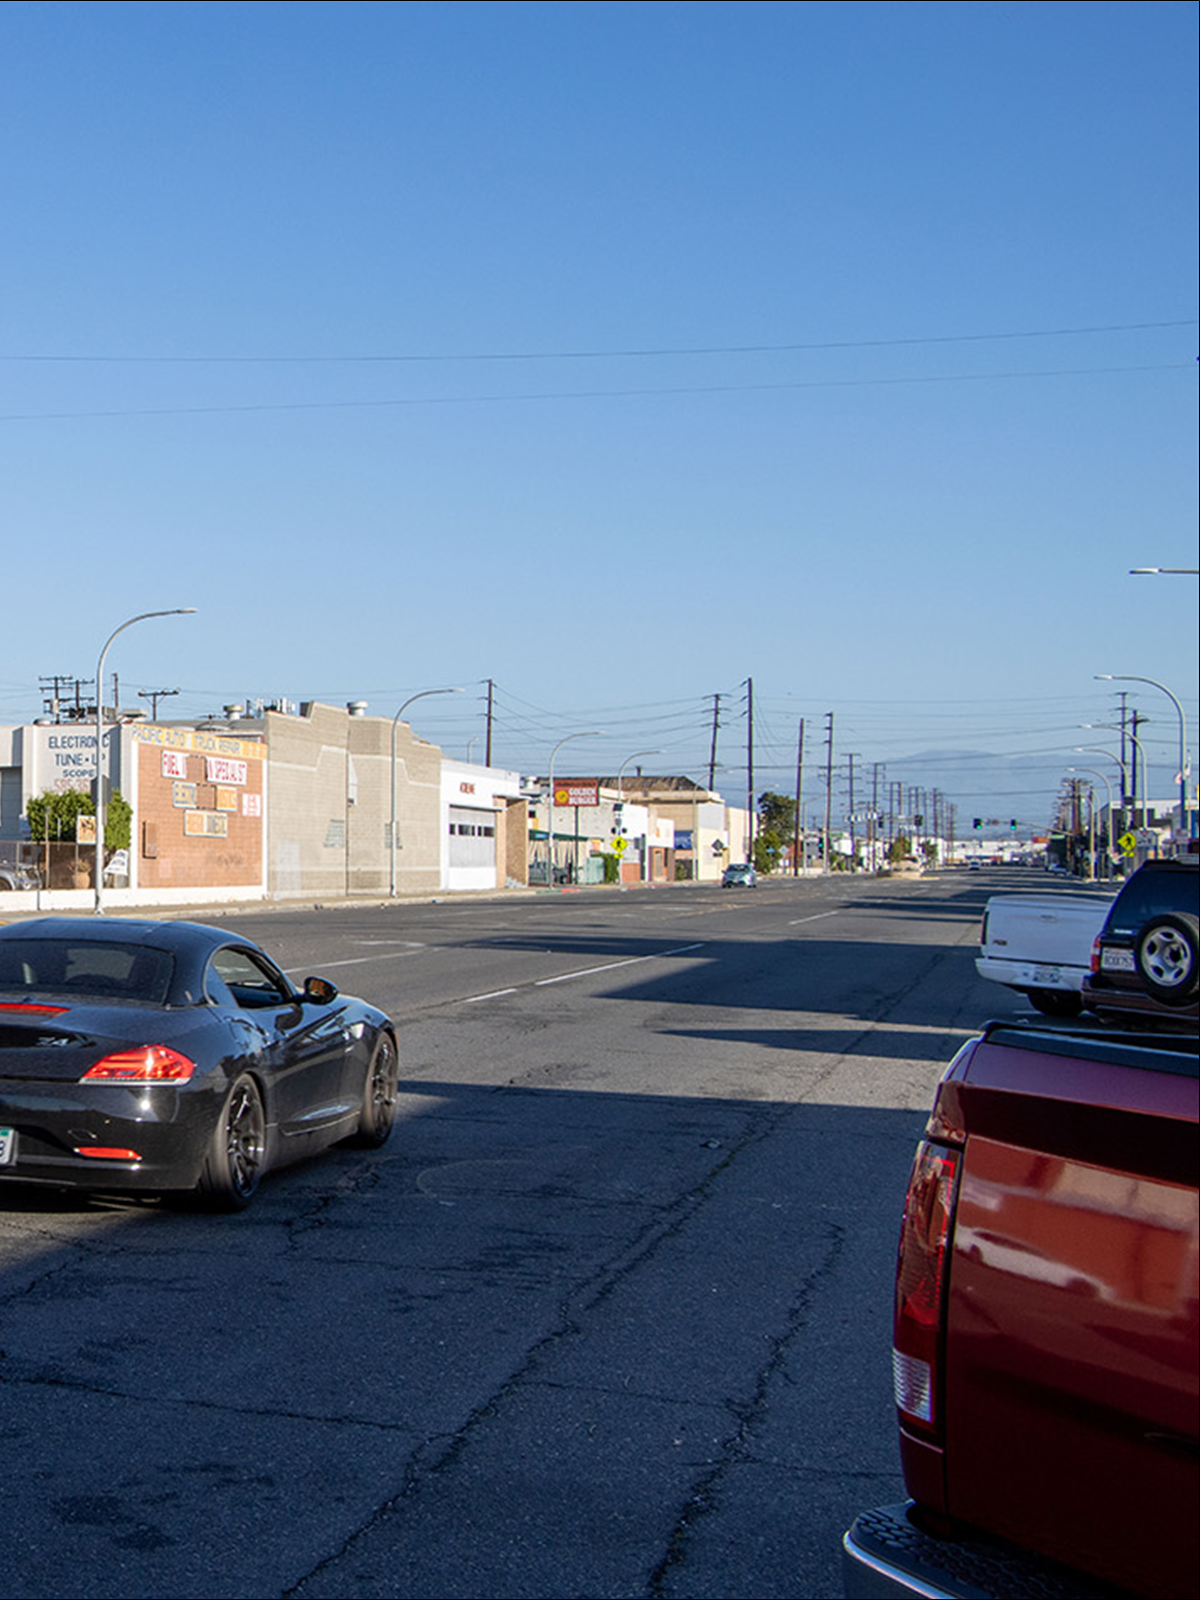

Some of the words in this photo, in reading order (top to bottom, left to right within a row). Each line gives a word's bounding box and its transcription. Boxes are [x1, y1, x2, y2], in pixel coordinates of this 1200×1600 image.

[132, 724, 162, 743] PACIFIC
[48, 735, 109, 748] ELECTRONC
[63, 769, 94, 778] SCOPE
